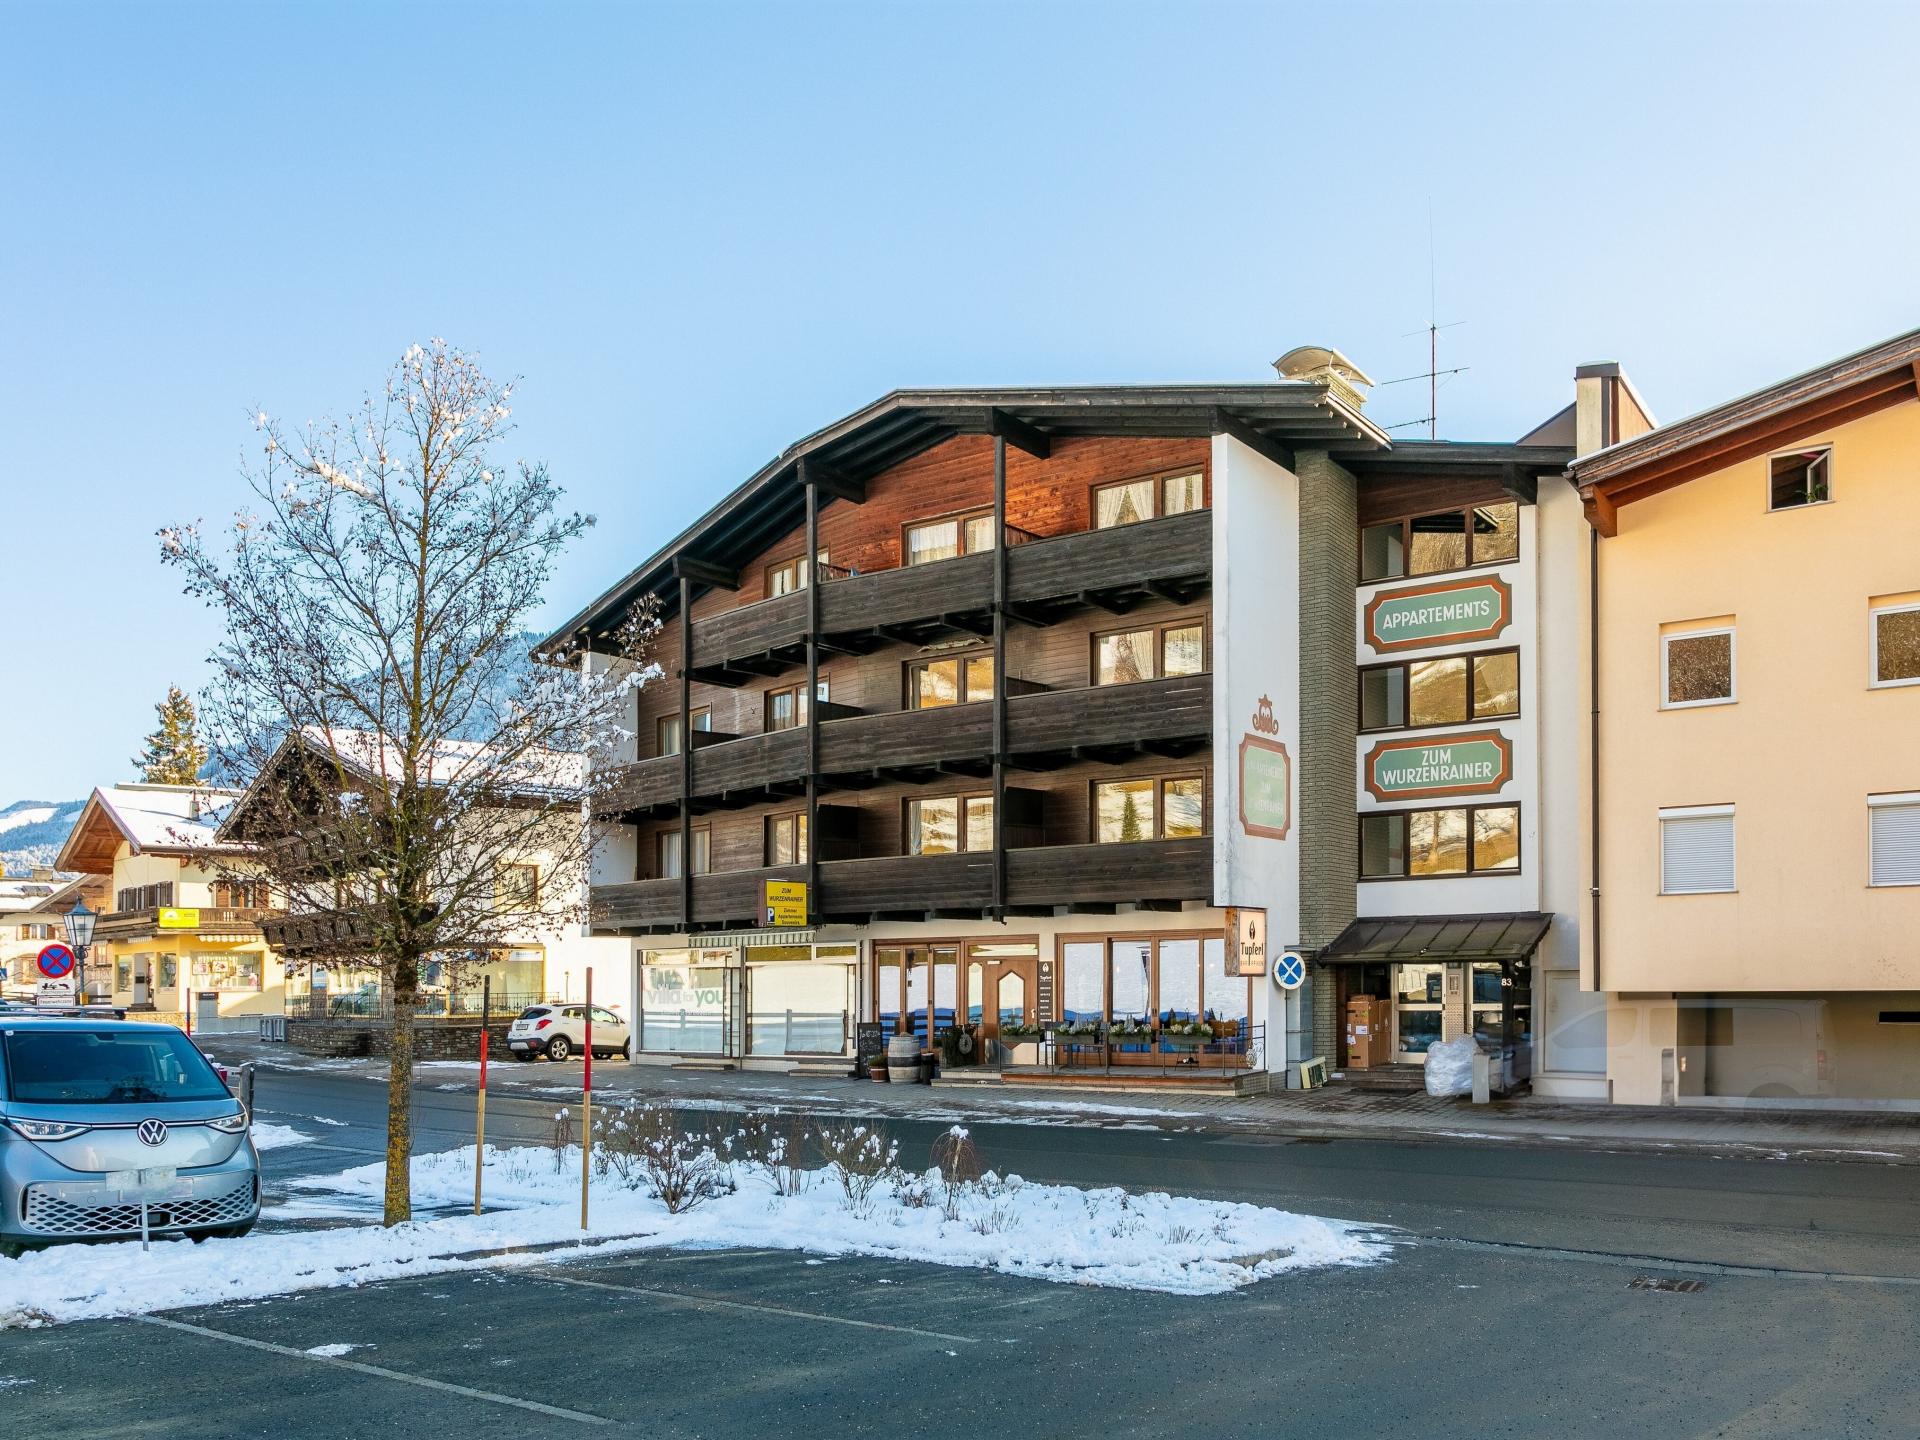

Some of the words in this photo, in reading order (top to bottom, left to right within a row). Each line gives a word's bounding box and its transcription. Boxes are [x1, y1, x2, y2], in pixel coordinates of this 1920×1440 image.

[1383, 600, 1490, 630] APPARTEMENTS
[1422, 748, 1451, 766] ZUM
[1383, 762, 1492, 785] WURZENRAINER
[1241, 941, 1264, 966] Tupferl
[1501, 977, 1512, 987] 83
